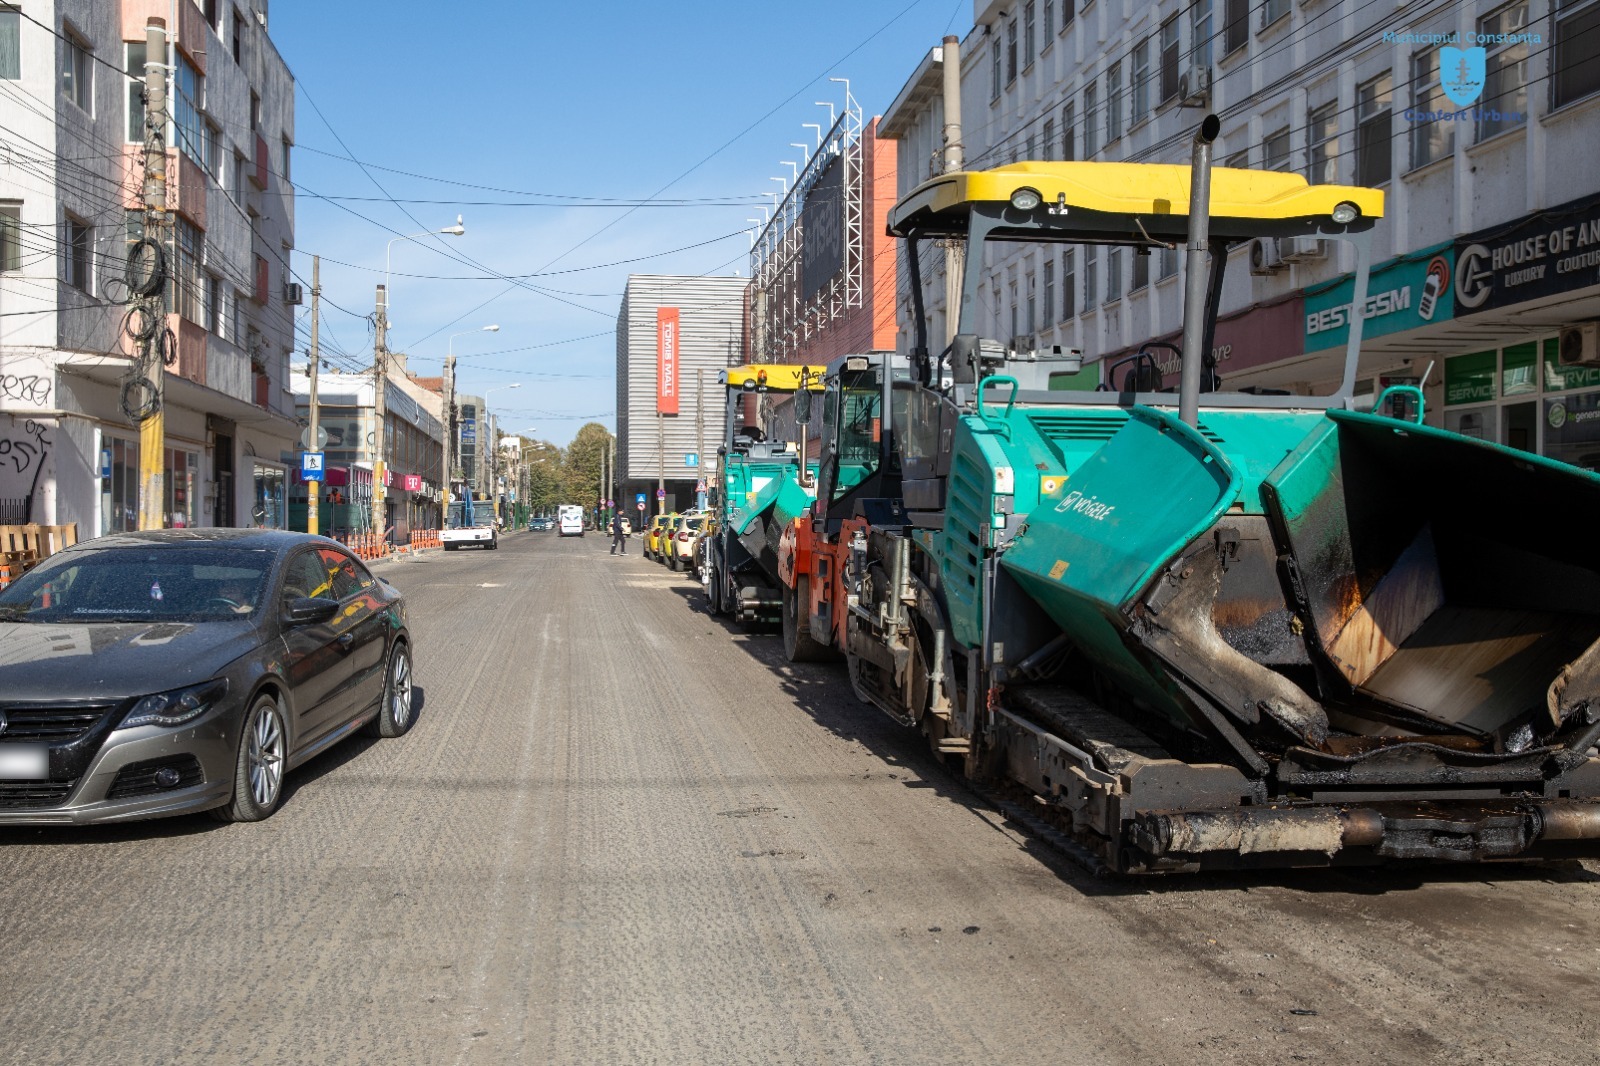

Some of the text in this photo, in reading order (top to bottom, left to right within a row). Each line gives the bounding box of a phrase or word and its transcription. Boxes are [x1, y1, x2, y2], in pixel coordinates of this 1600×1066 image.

[1492, 234, 1547, 271] HOUSE
[1549, 226, 1575, 254] OF
[1504, 264, 1547, 288] LUXURY
[1306, 285, 1411, 335] BEST GSM
[664, 321, 673, 397] TOMIS MALL
[1211, 343, 1232, 362] ore
[1072, 495, 1116, 521] VÖGELE
